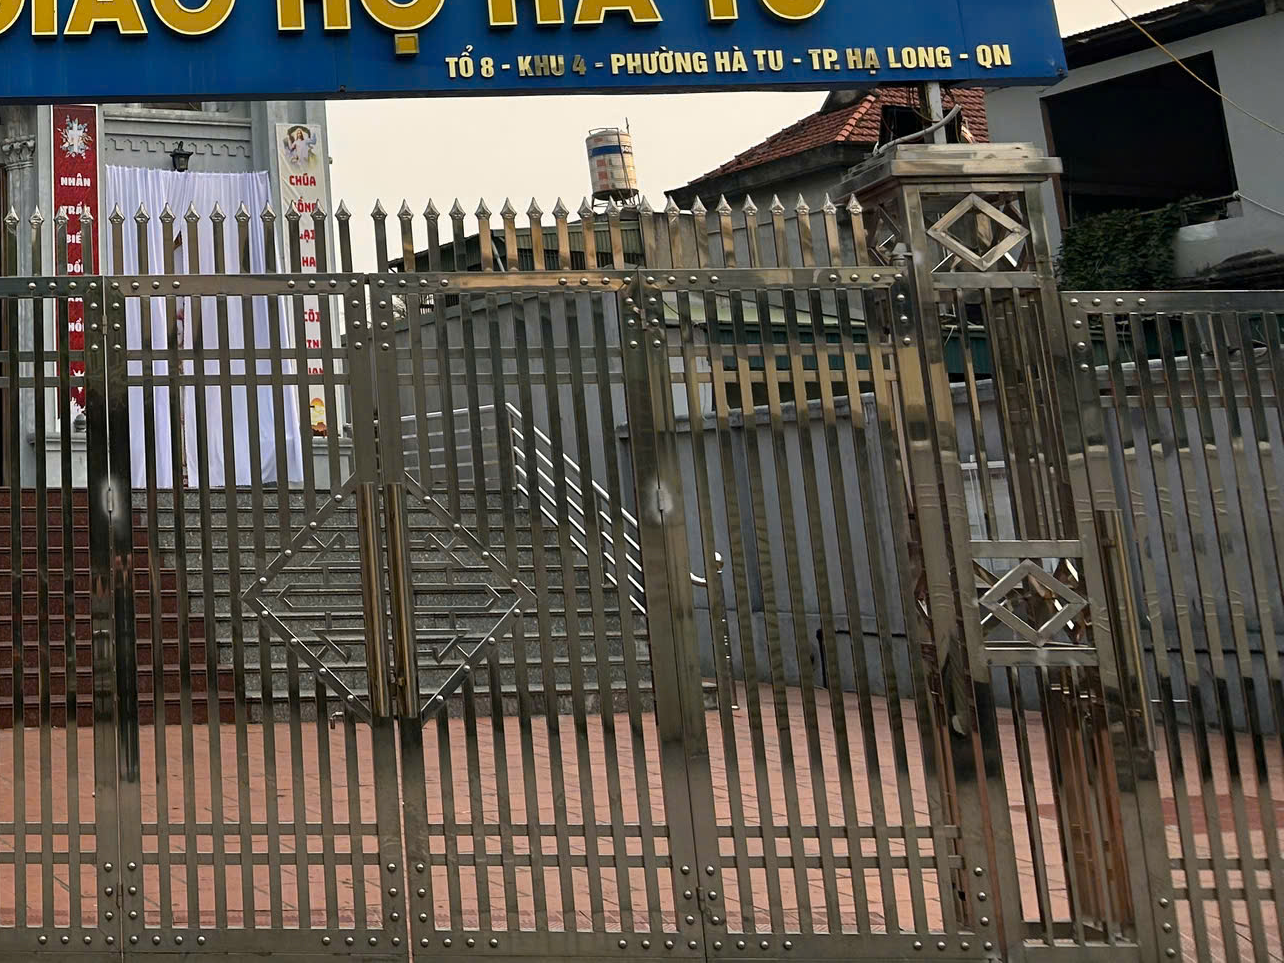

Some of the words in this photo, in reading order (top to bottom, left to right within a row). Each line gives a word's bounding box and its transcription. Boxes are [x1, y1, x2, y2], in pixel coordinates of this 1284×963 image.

[445, 45, 474, 78] TỔ
[480, 57, 494, 78] 8
[517, 54, 565, 77] KHU
[572, 55, 586, 76] 4
[610, 46, 709, 75] PHƯỜNG
[715, 46, 748, 73] HÀ
[753, 49, 783, 71] TU
[808, 48, 841, 71] TP.
[846, 47, 881, 75] HẠ
[887, 46, 952, 69] LONG
[976, 44, 1012, 68] QN
[60, 173, 91, 187] NHÂN
